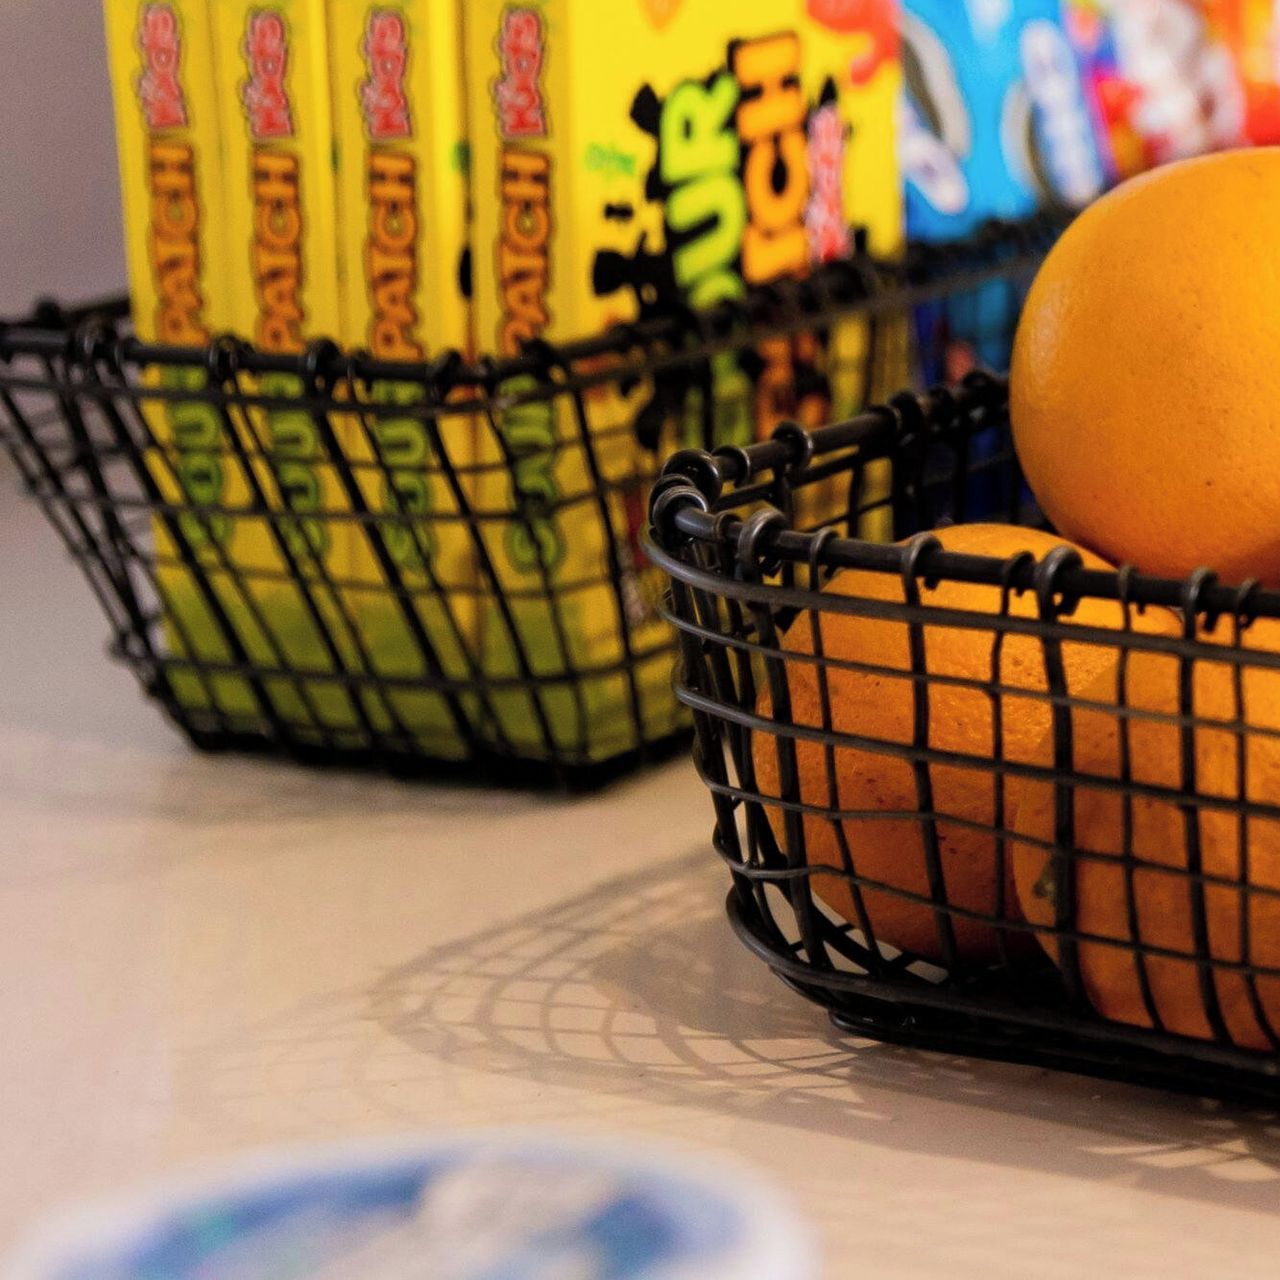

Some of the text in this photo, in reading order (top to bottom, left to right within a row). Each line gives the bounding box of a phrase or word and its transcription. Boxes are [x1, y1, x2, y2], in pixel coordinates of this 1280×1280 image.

[149, 143, 208, 346] PATCH
[253, 153, 305, 354] PATCH
[368, 152, 425, 360] PATCH
